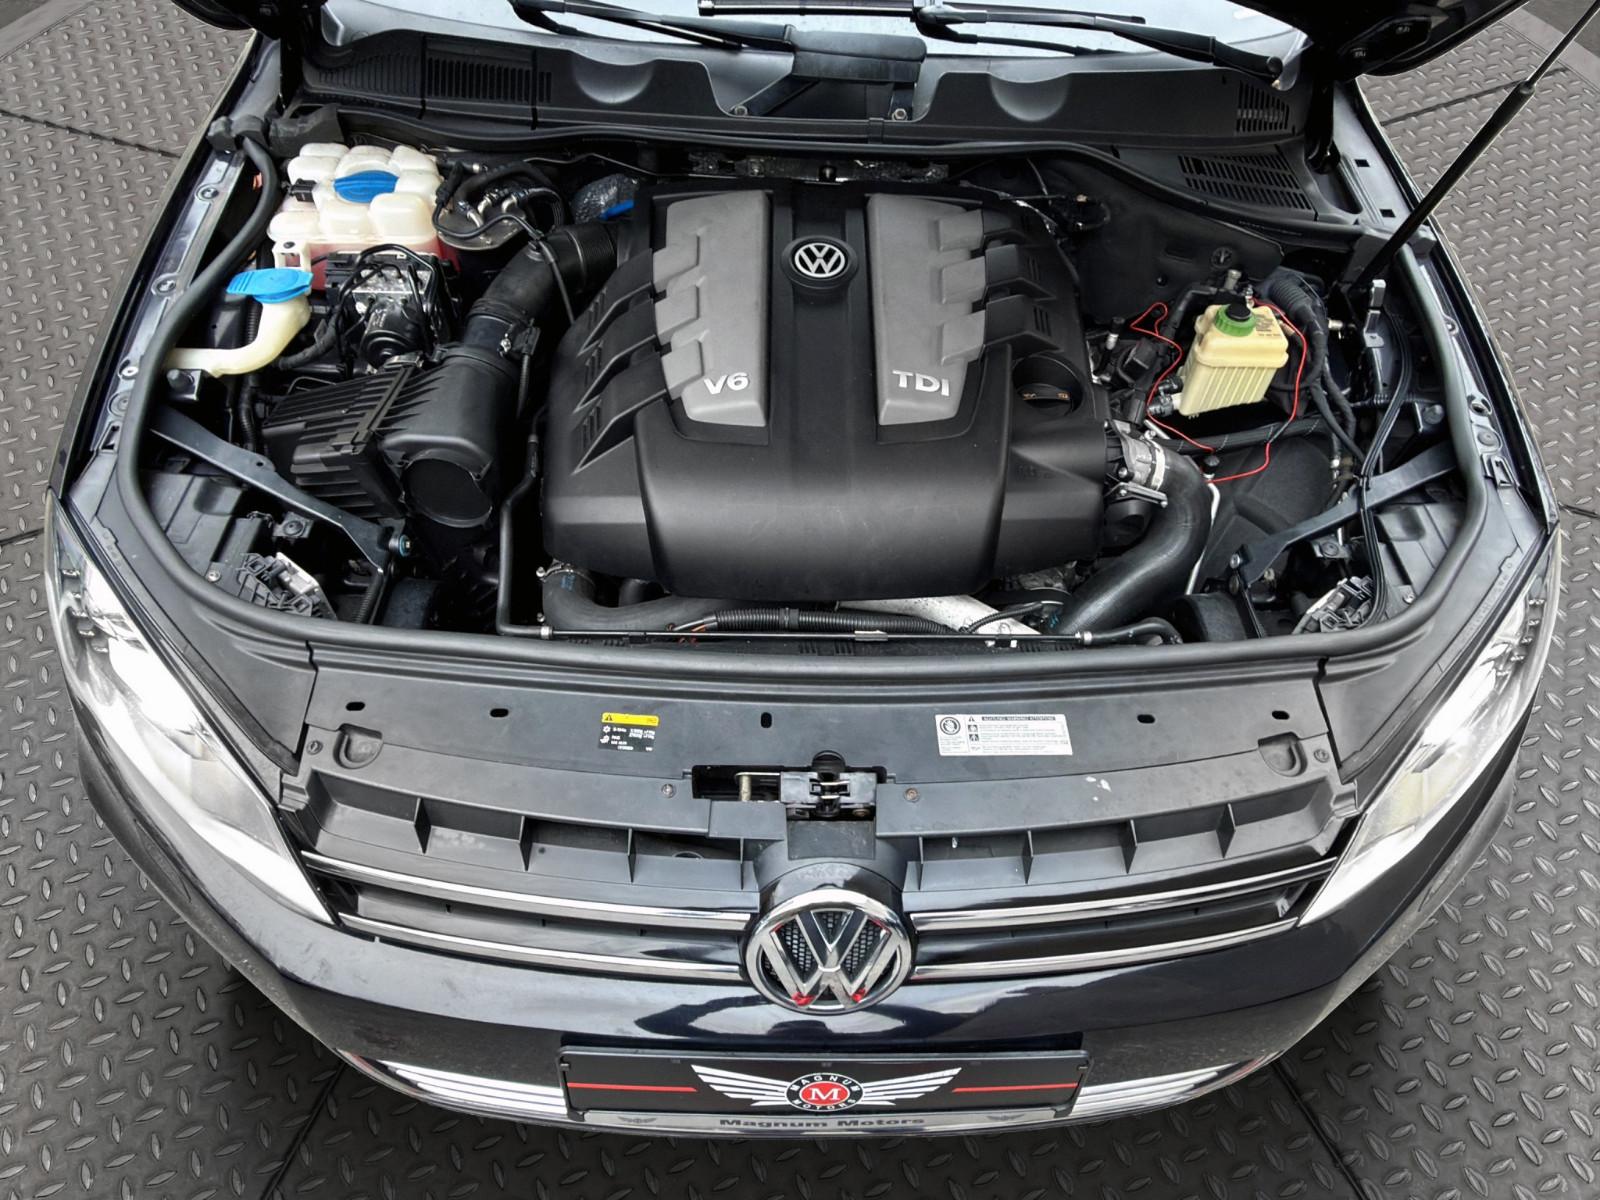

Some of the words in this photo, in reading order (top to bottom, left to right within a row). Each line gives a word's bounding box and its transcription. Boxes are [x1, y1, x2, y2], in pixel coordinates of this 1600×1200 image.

[703, 372, 749, 395] V6
[892, 369, 950, 396] TDI
[790, 1075, 861, 1092] MAGNUM
[808, 1087, 841, 1101] M
[792, 1098, 857, 1111] MOTORS
[719, 1118, 828, 1128] Magnum
[837, 1118, 925, 1127] Motors
